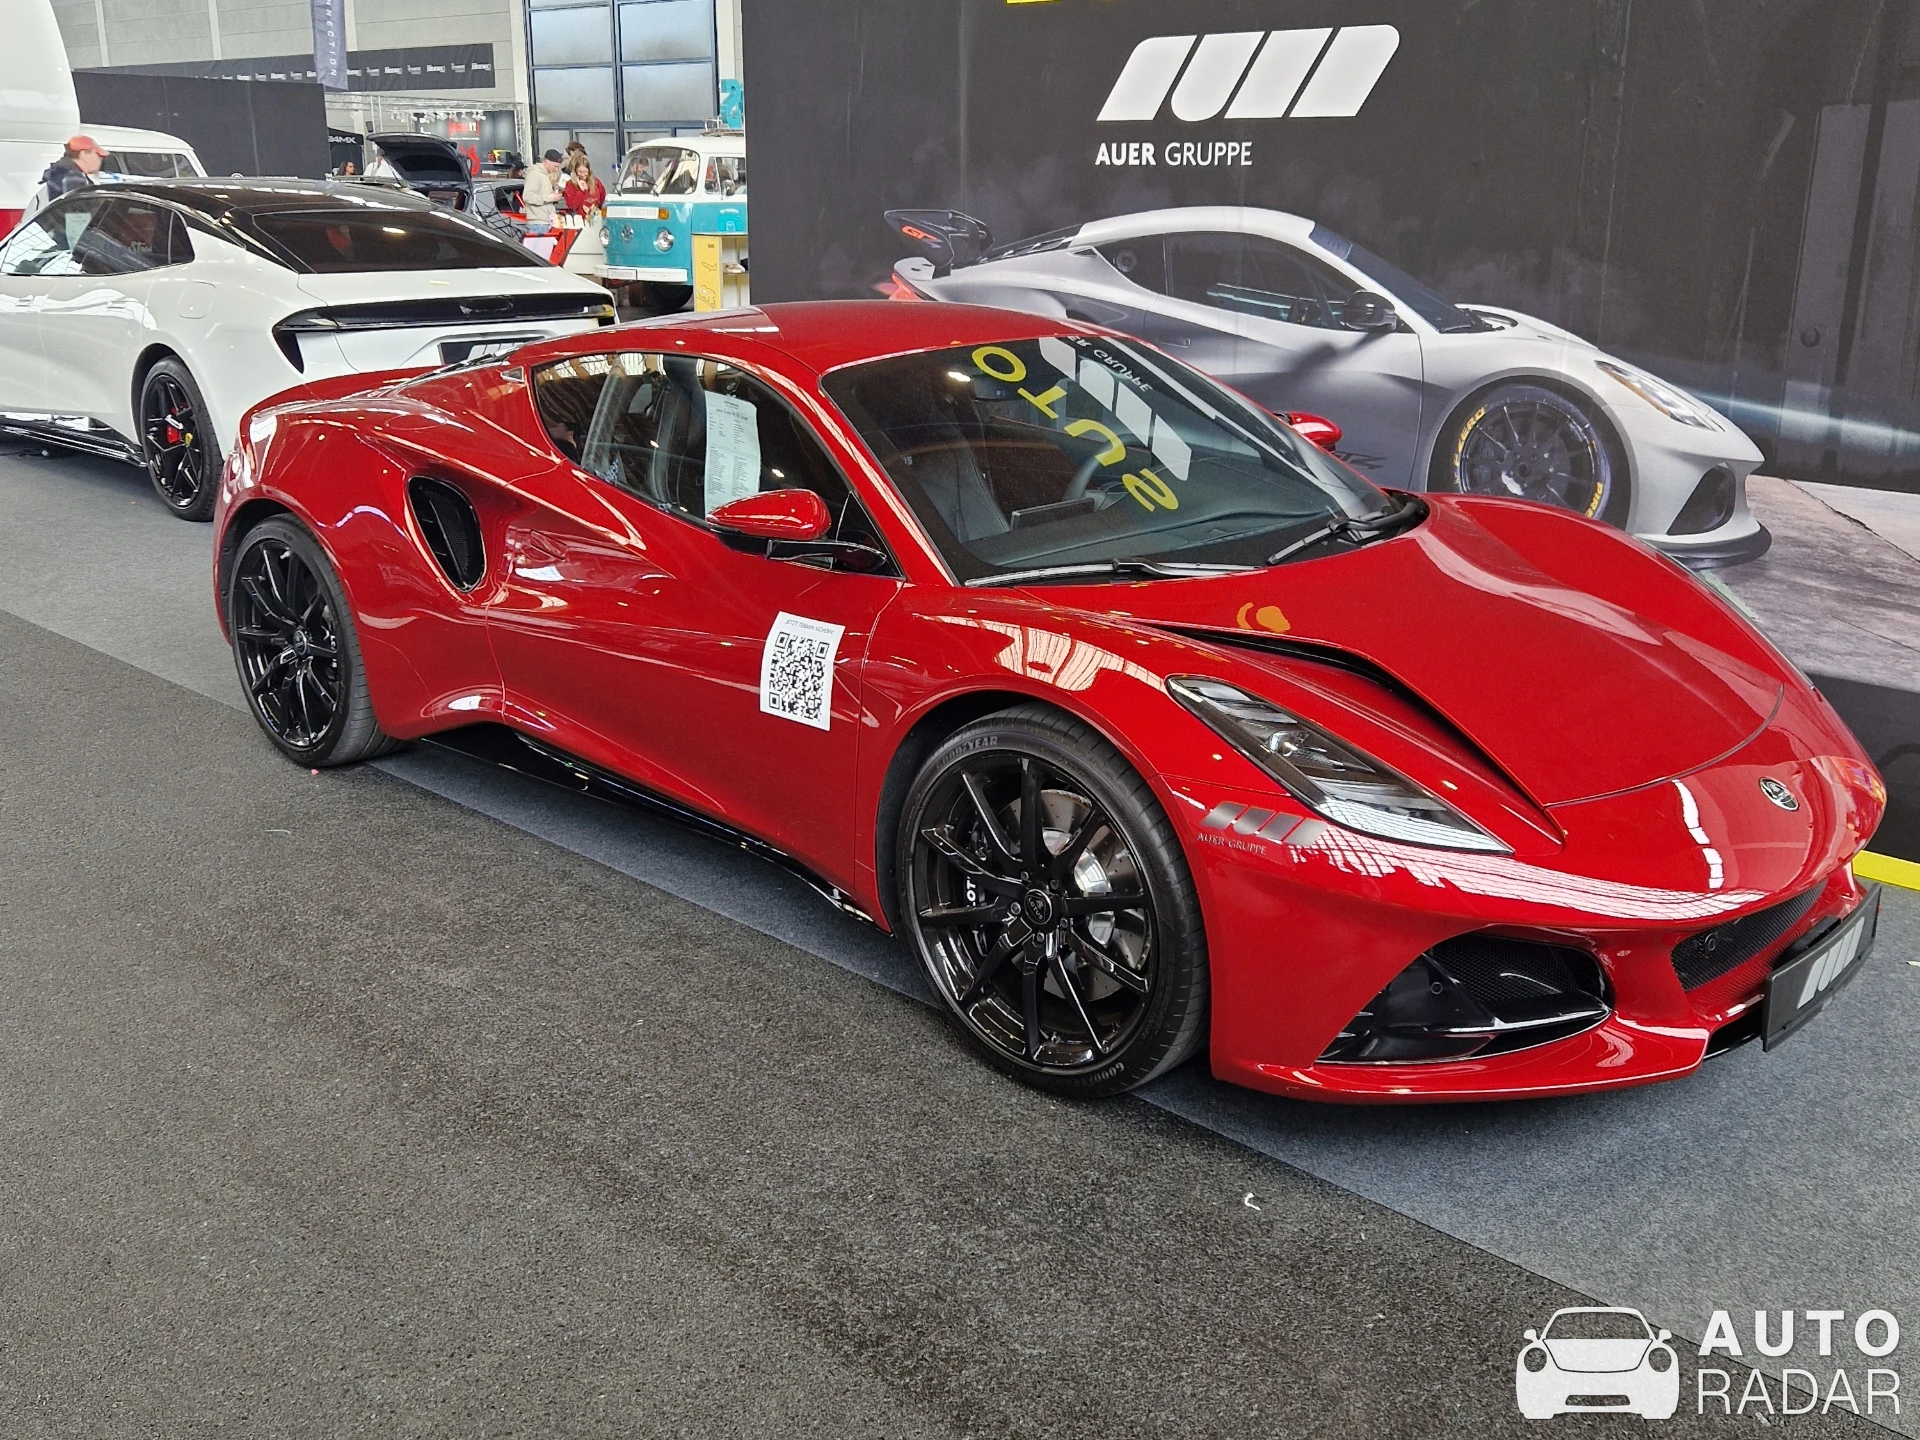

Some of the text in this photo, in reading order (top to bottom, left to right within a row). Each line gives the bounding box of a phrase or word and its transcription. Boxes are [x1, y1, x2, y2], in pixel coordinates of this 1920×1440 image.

[1095, 141, 1253, 166] AUER GRUPPE
[1197, 832, 1267, 855] AUER GRUPPE
